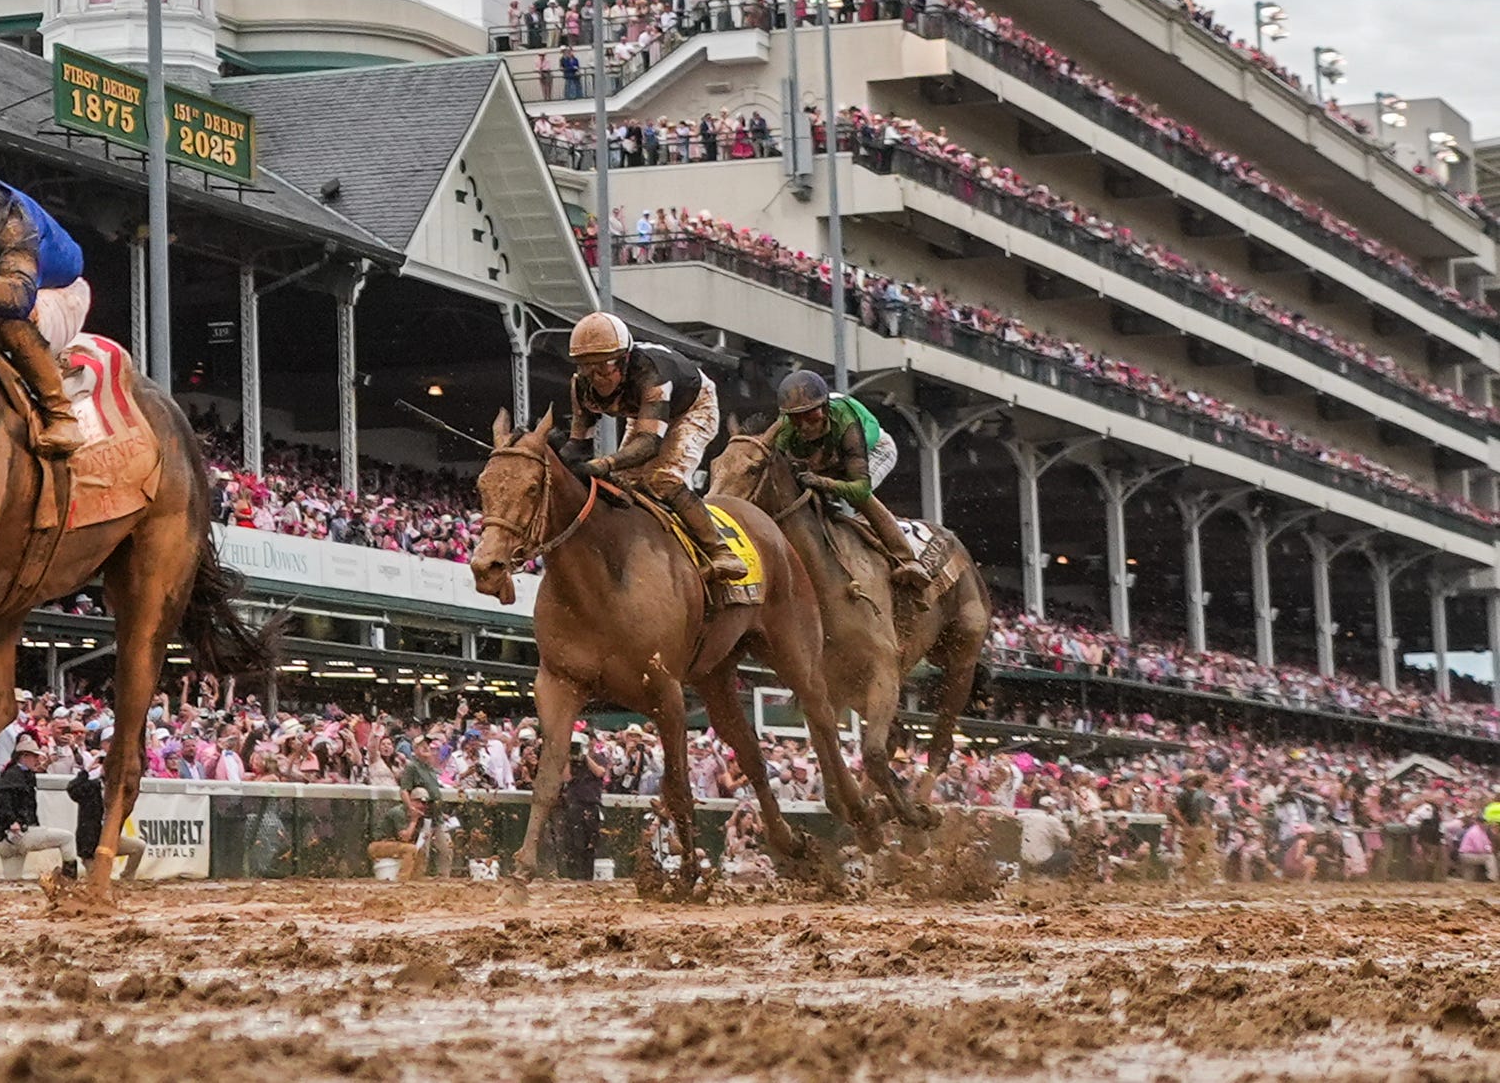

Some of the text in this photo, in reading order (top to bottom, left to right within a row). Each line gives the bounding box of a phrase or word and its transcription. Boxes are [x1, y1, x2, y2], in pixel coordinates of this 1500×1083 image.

[63, 63, 141, 106] FIRST DERBY
[71, 88, 135, 133] 1875
[203, 112, 245, 141] DERBY
[180, 125, 237, 166] 2025
[263, 540, 308, 574] DOWNS
[138, 819, 205, 846] SUNBELT
[148, 847, 196, 858] RENTALS
